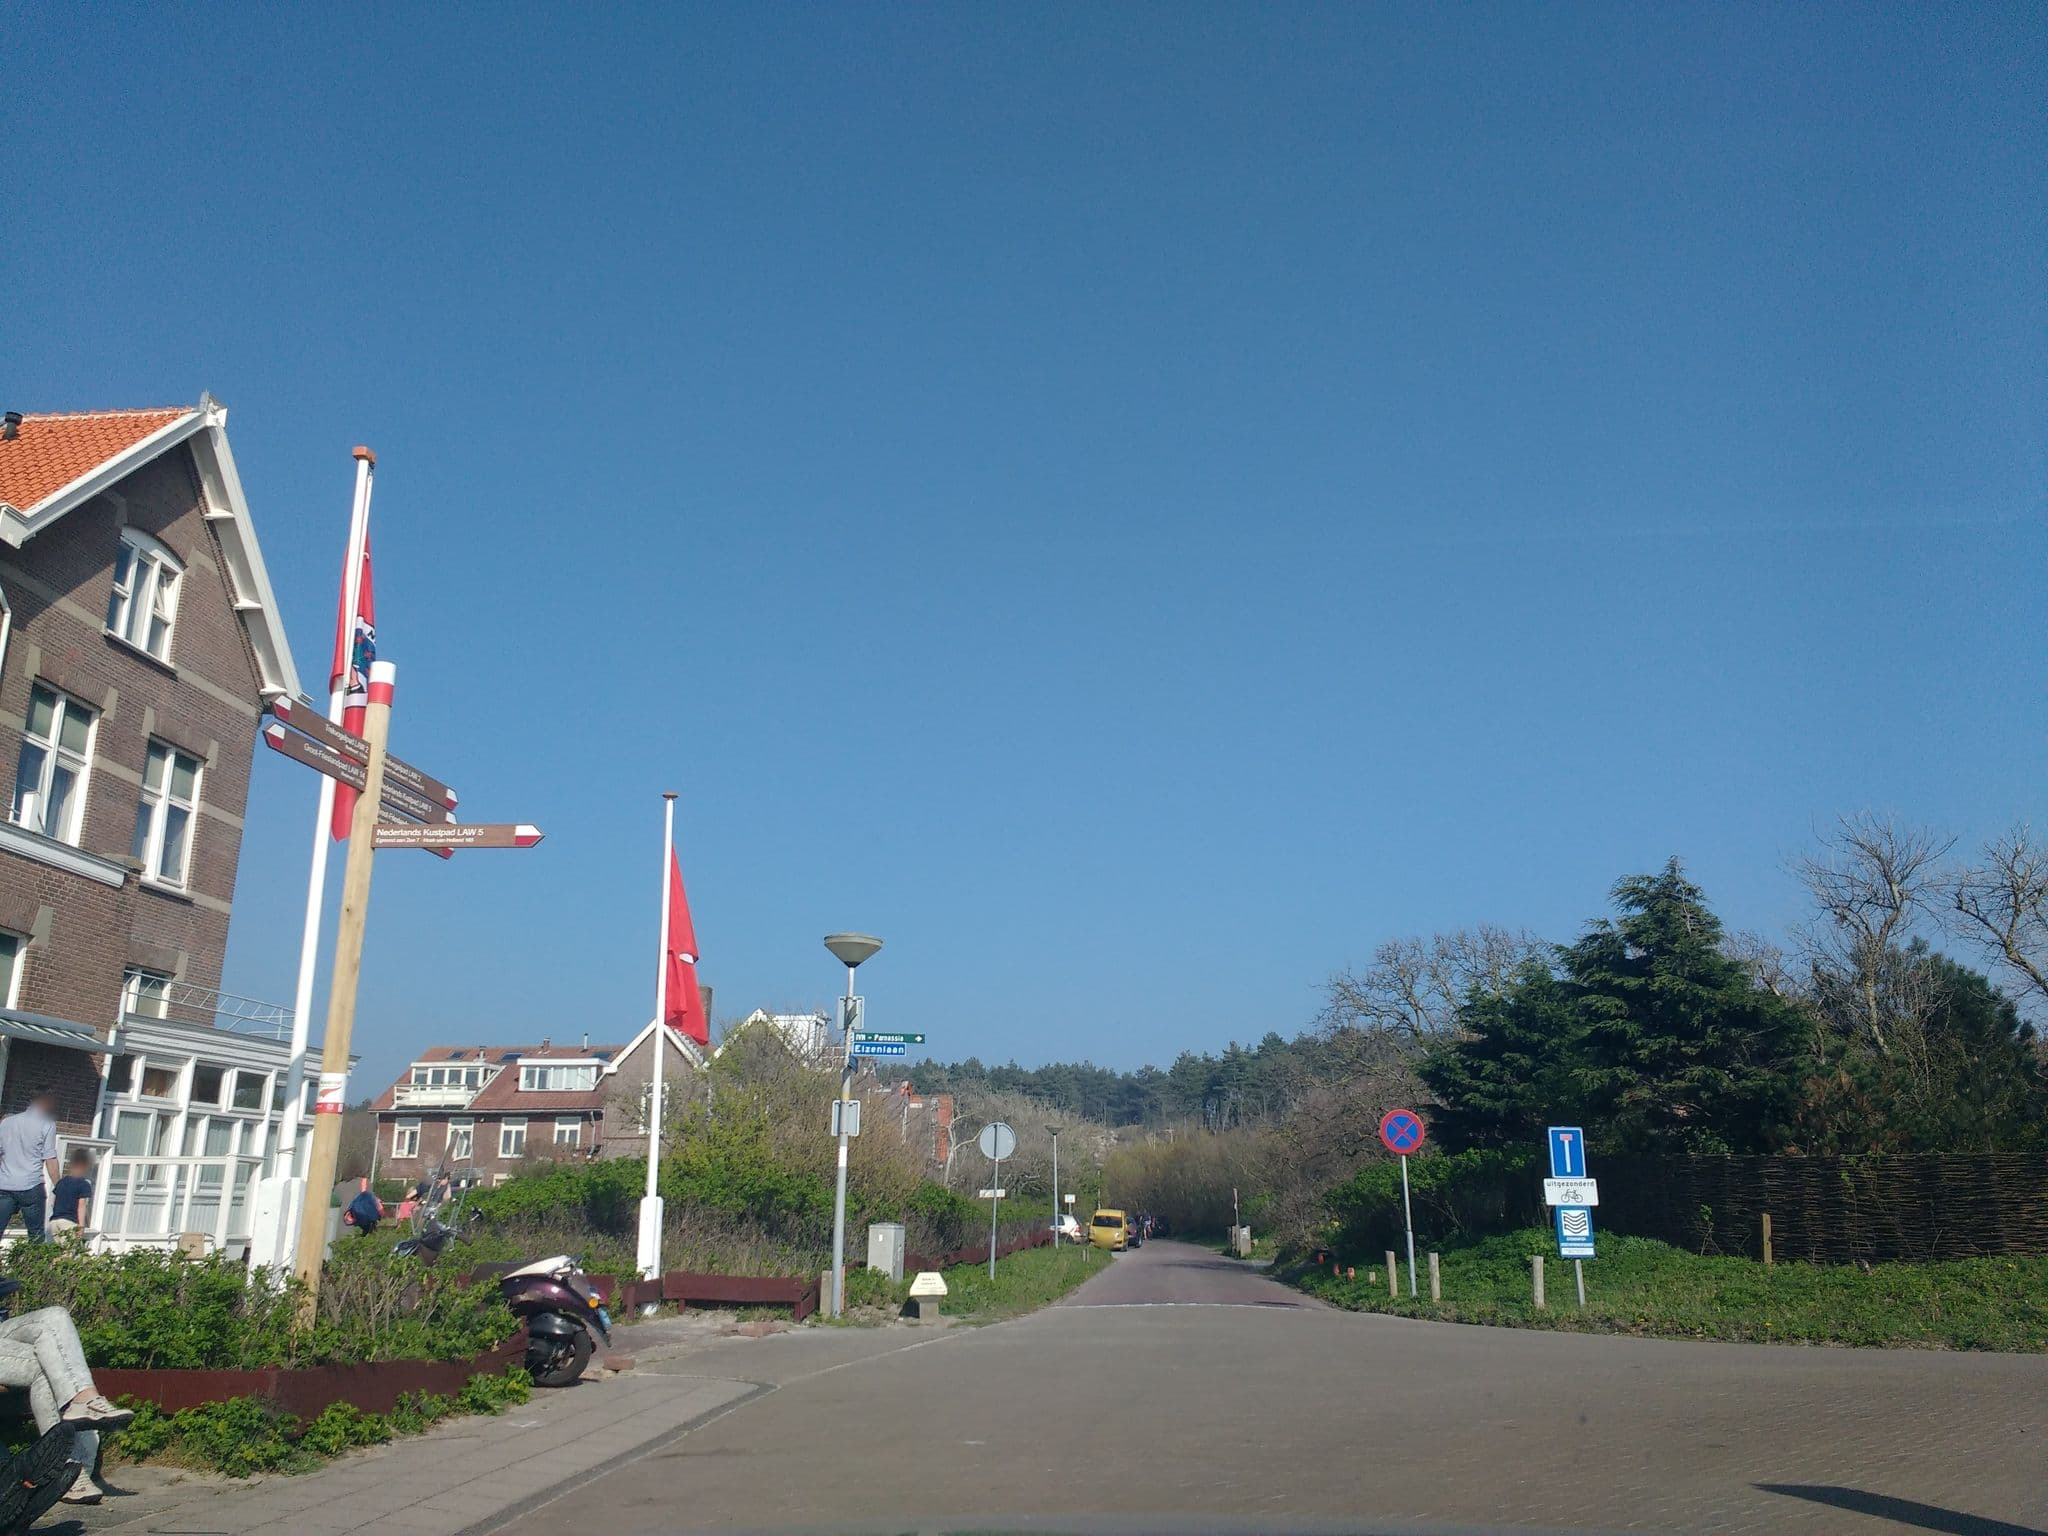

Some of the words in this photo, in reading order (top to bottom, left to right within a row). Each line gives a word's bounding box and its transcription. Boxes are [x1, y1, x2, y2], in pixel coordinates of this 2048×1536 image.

[377, 828, 421, 836] Nederlands
[423, 828, 456, 838] Kustpad
[457, 828, 477, 836] LAW
[478, 828, 484, 836] 5
[874, 1033, 904, 1042] Parnassia
[855, 1044, 904, 1054] Elzenlaan
